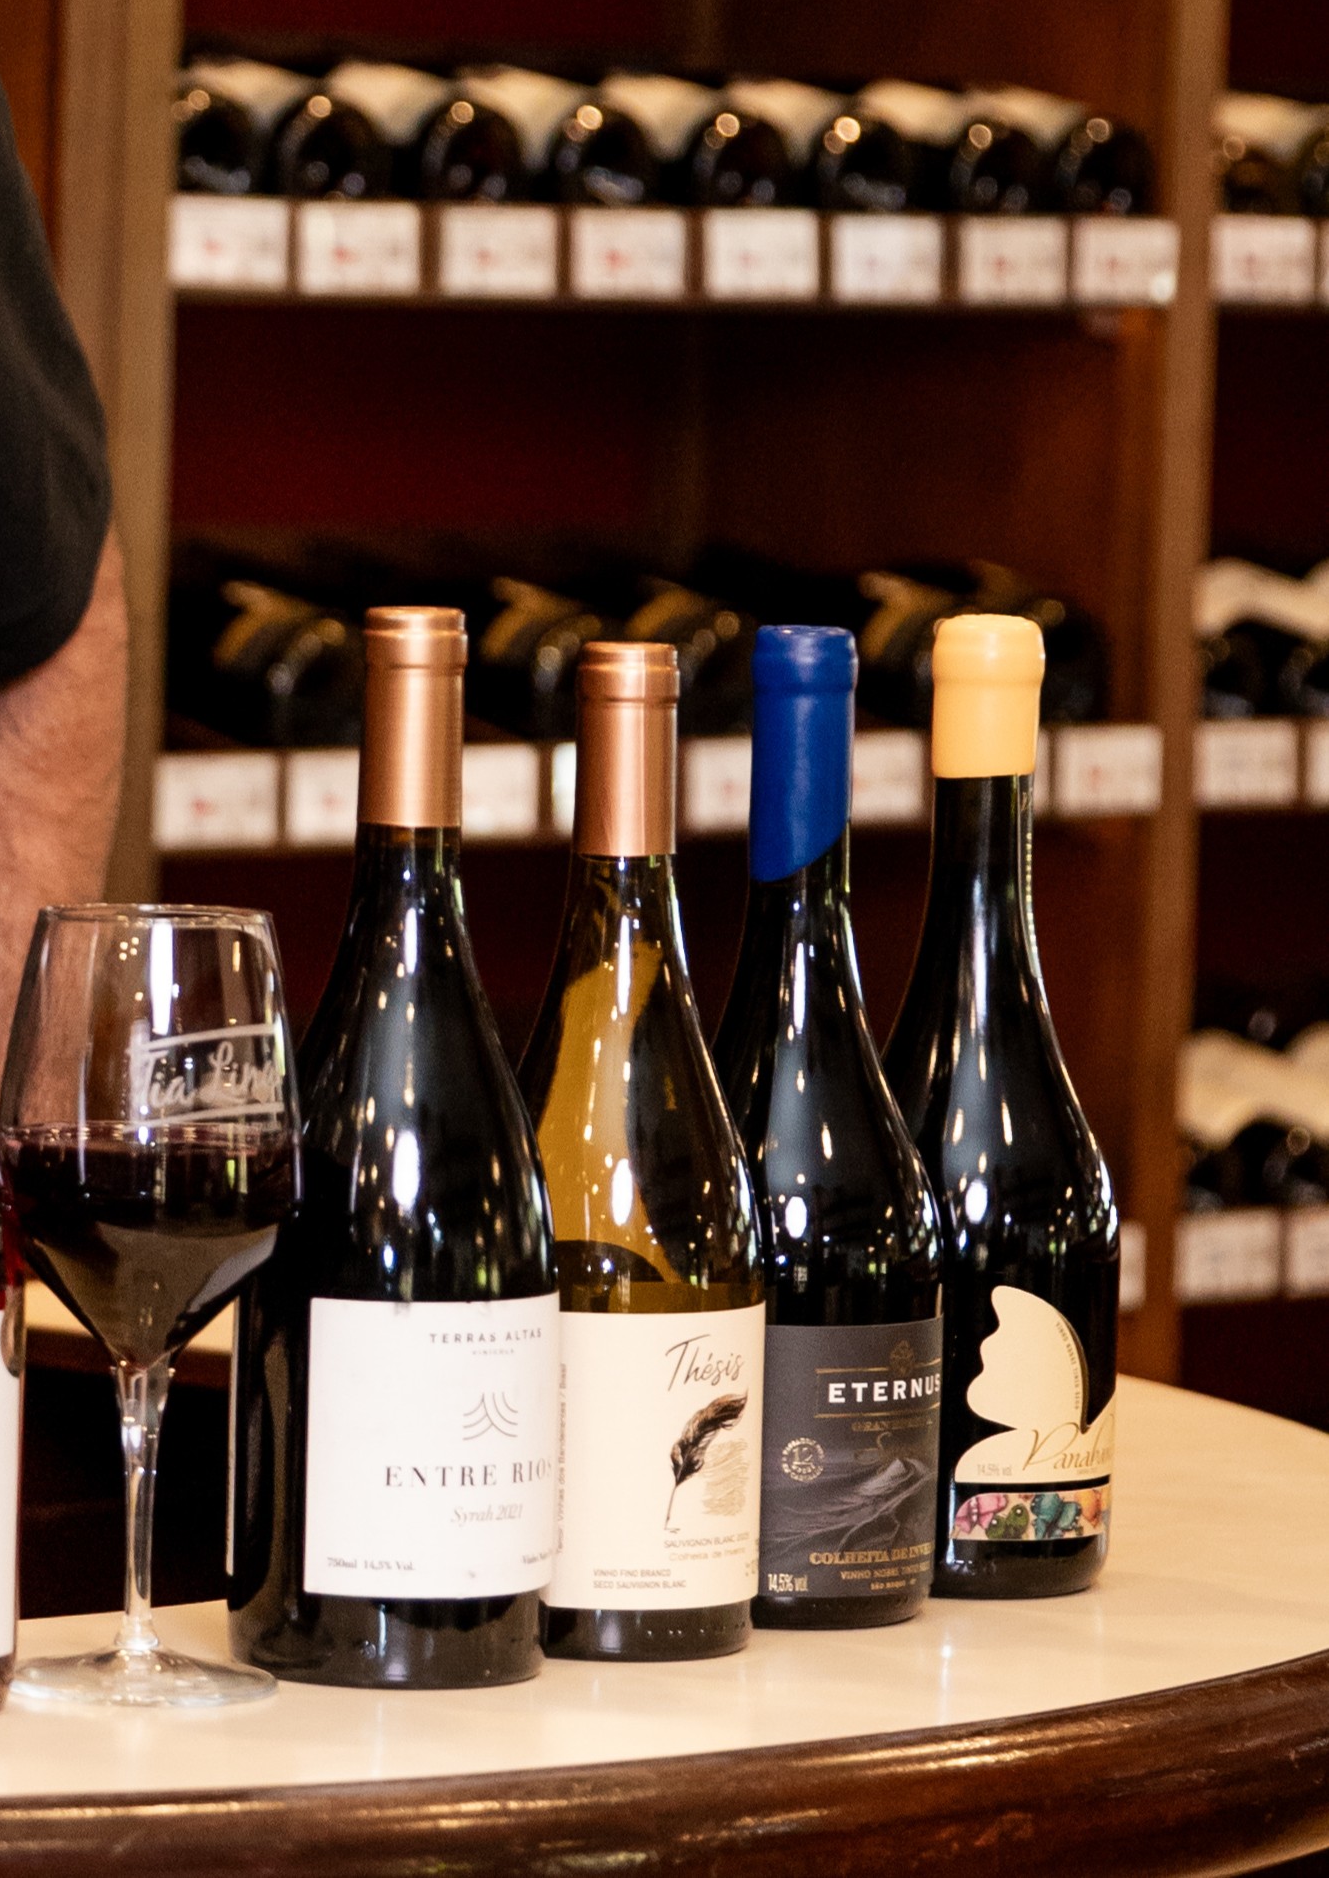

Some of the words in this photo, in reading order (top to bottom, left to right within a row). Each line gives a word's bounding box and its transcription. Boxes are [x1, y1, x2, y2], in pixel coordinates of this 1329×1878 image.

[430, 1331, 497, 1344] TERRAS
[506, 1328, 542, 1340] ALTAS
[665, 1334, 745, 1391] Thésis
[828, 1373, 941, 1404] ETERNUS
[385, 1464, 498, 1488] ENTRE
[451, 1504, 494, 1527] Syrah
[495, 1503, 524, 1521] 2021
[664, 1537, 713, 1549] SAUVIGNON
[593, 1569, 618, 1578] VINHO
[593, 1580, 614, 1589] SECO
